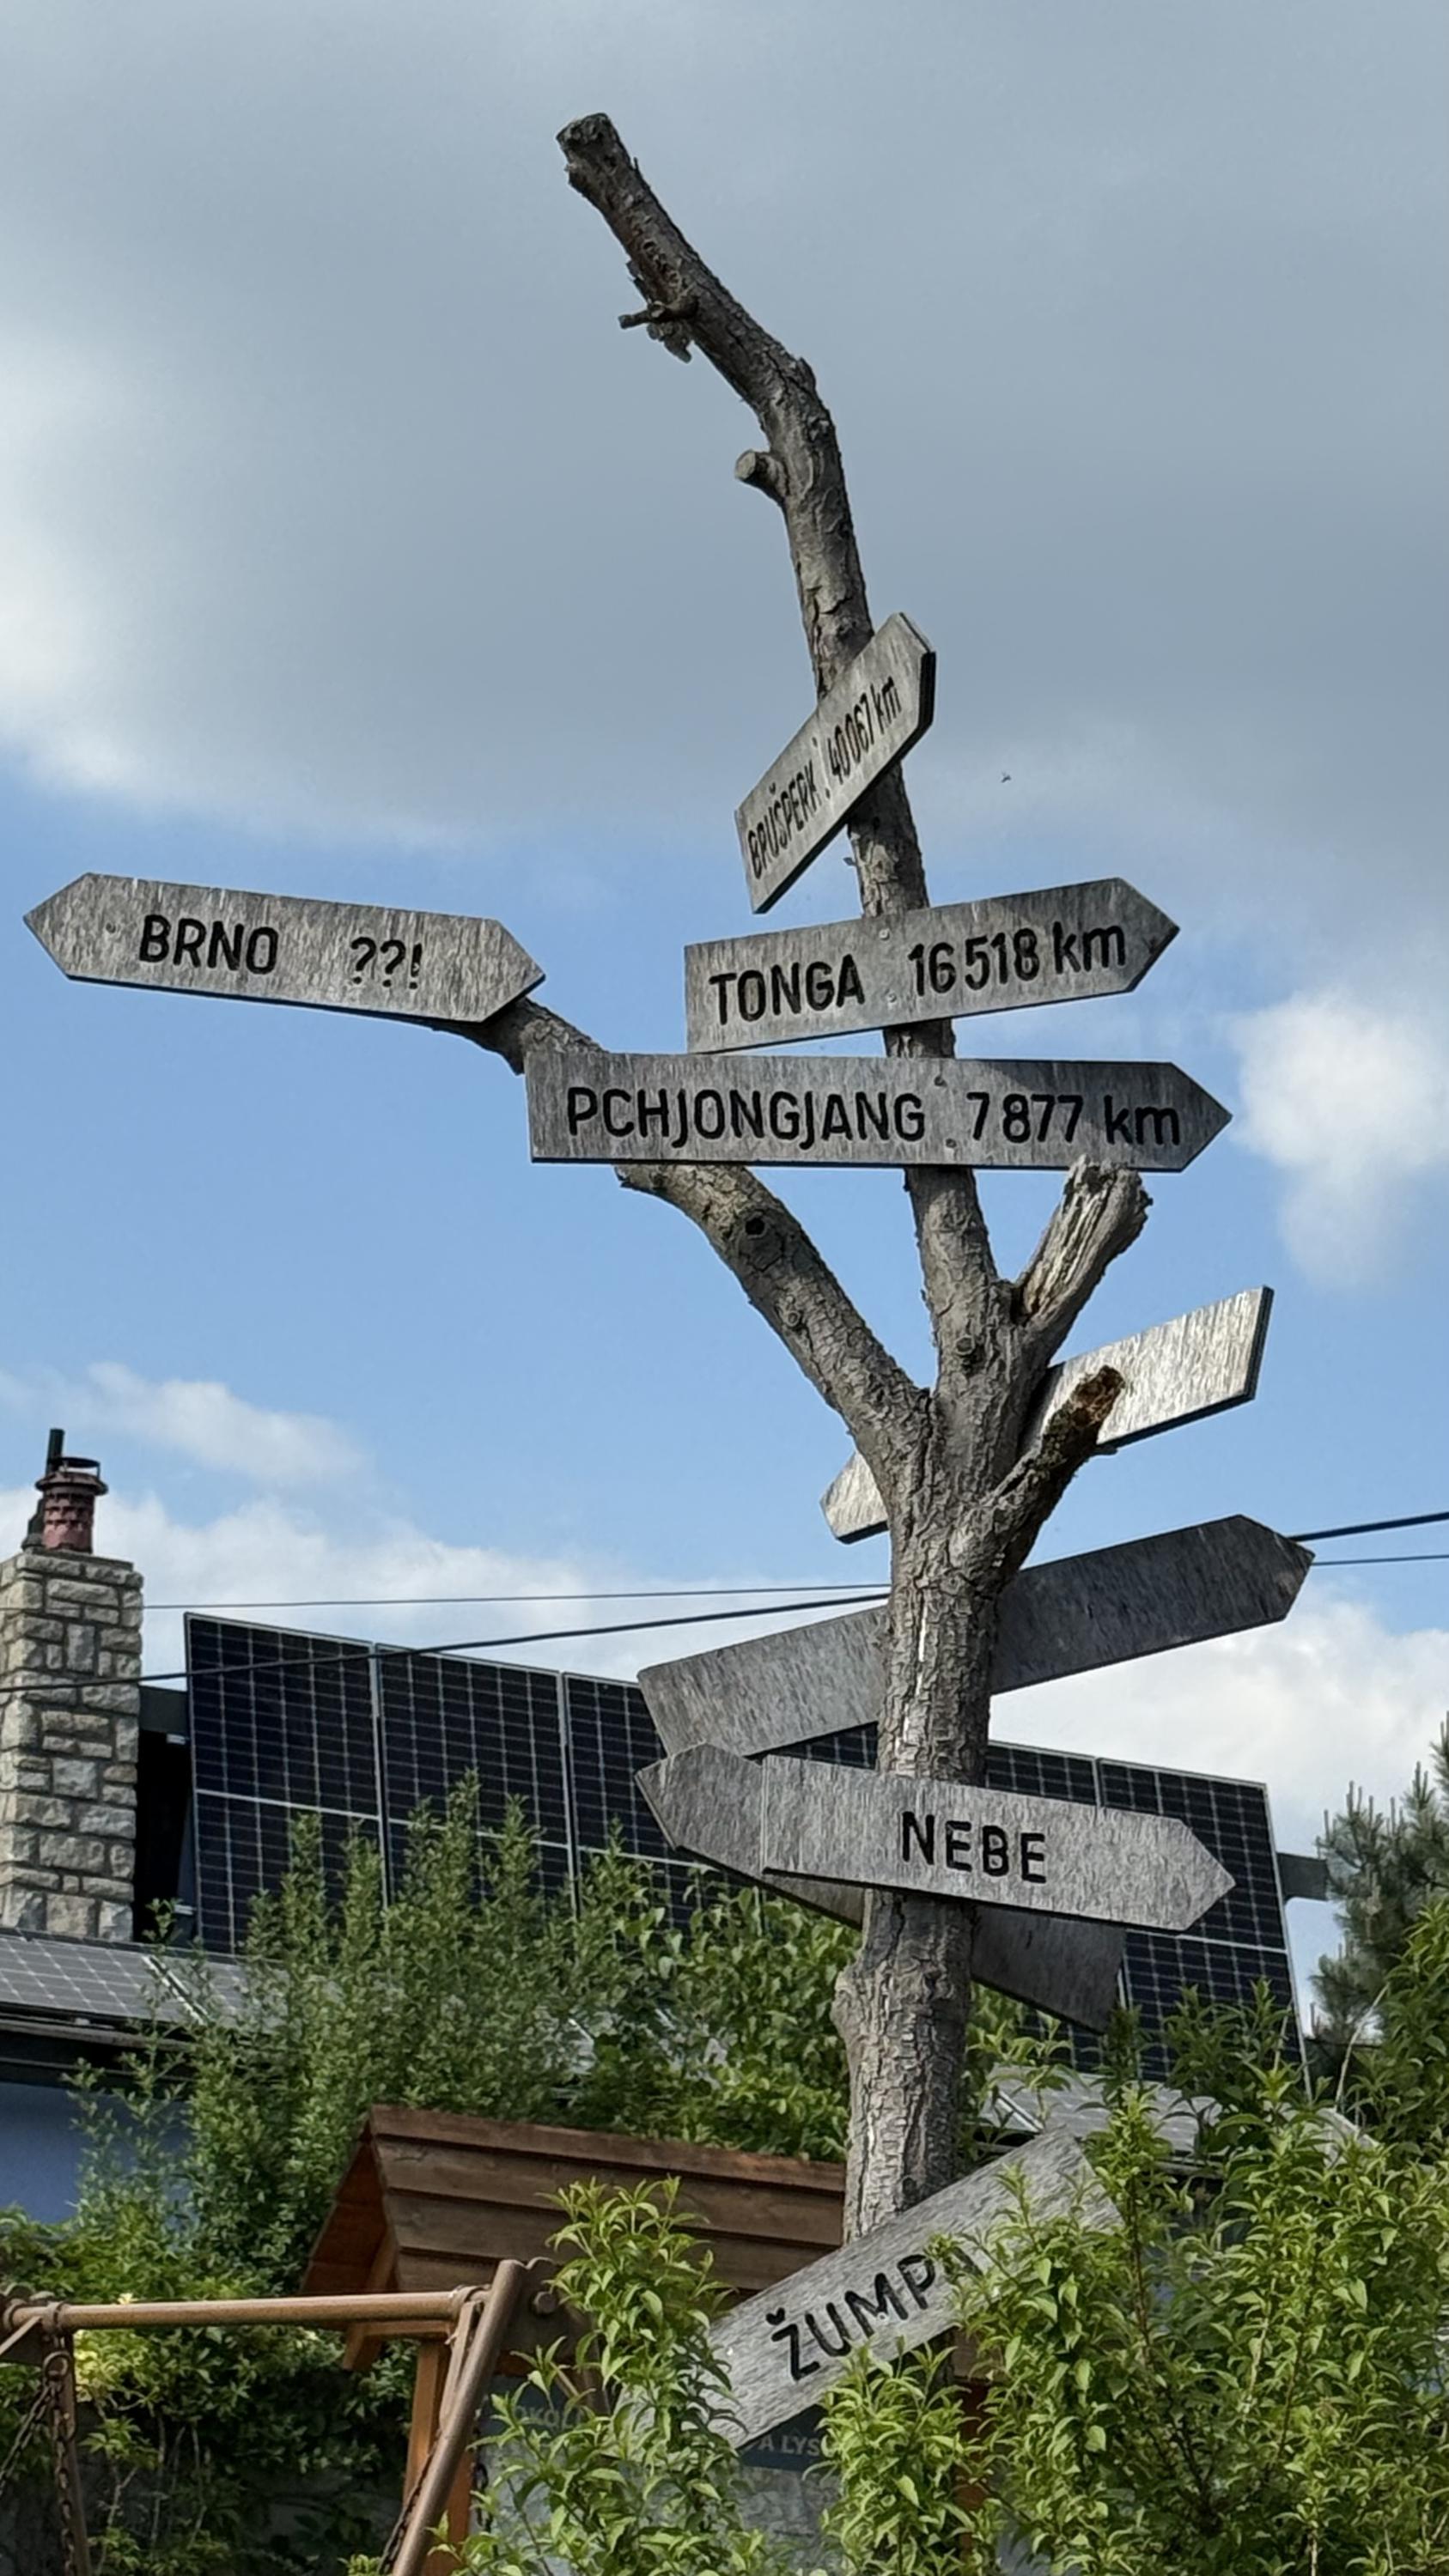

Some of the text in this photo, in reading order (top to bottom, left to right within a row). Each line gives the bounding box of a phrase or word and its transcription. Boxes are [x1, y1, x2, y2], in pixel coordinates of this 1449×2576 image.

[746, 759, 821, 880] BRUŠPERK
[870, 675, 902, 736] km
[137, 914, 423, 990] BRNO ??!
[709, 953, 865, 1025] TONGA
[1052, 920, 1126, 975] km
[566, 1086, 926, 1151] PCHJONGJANG
[1103, 1094, 1181, 1145] km
[901, 1811, 1048, 1884] NEBE
